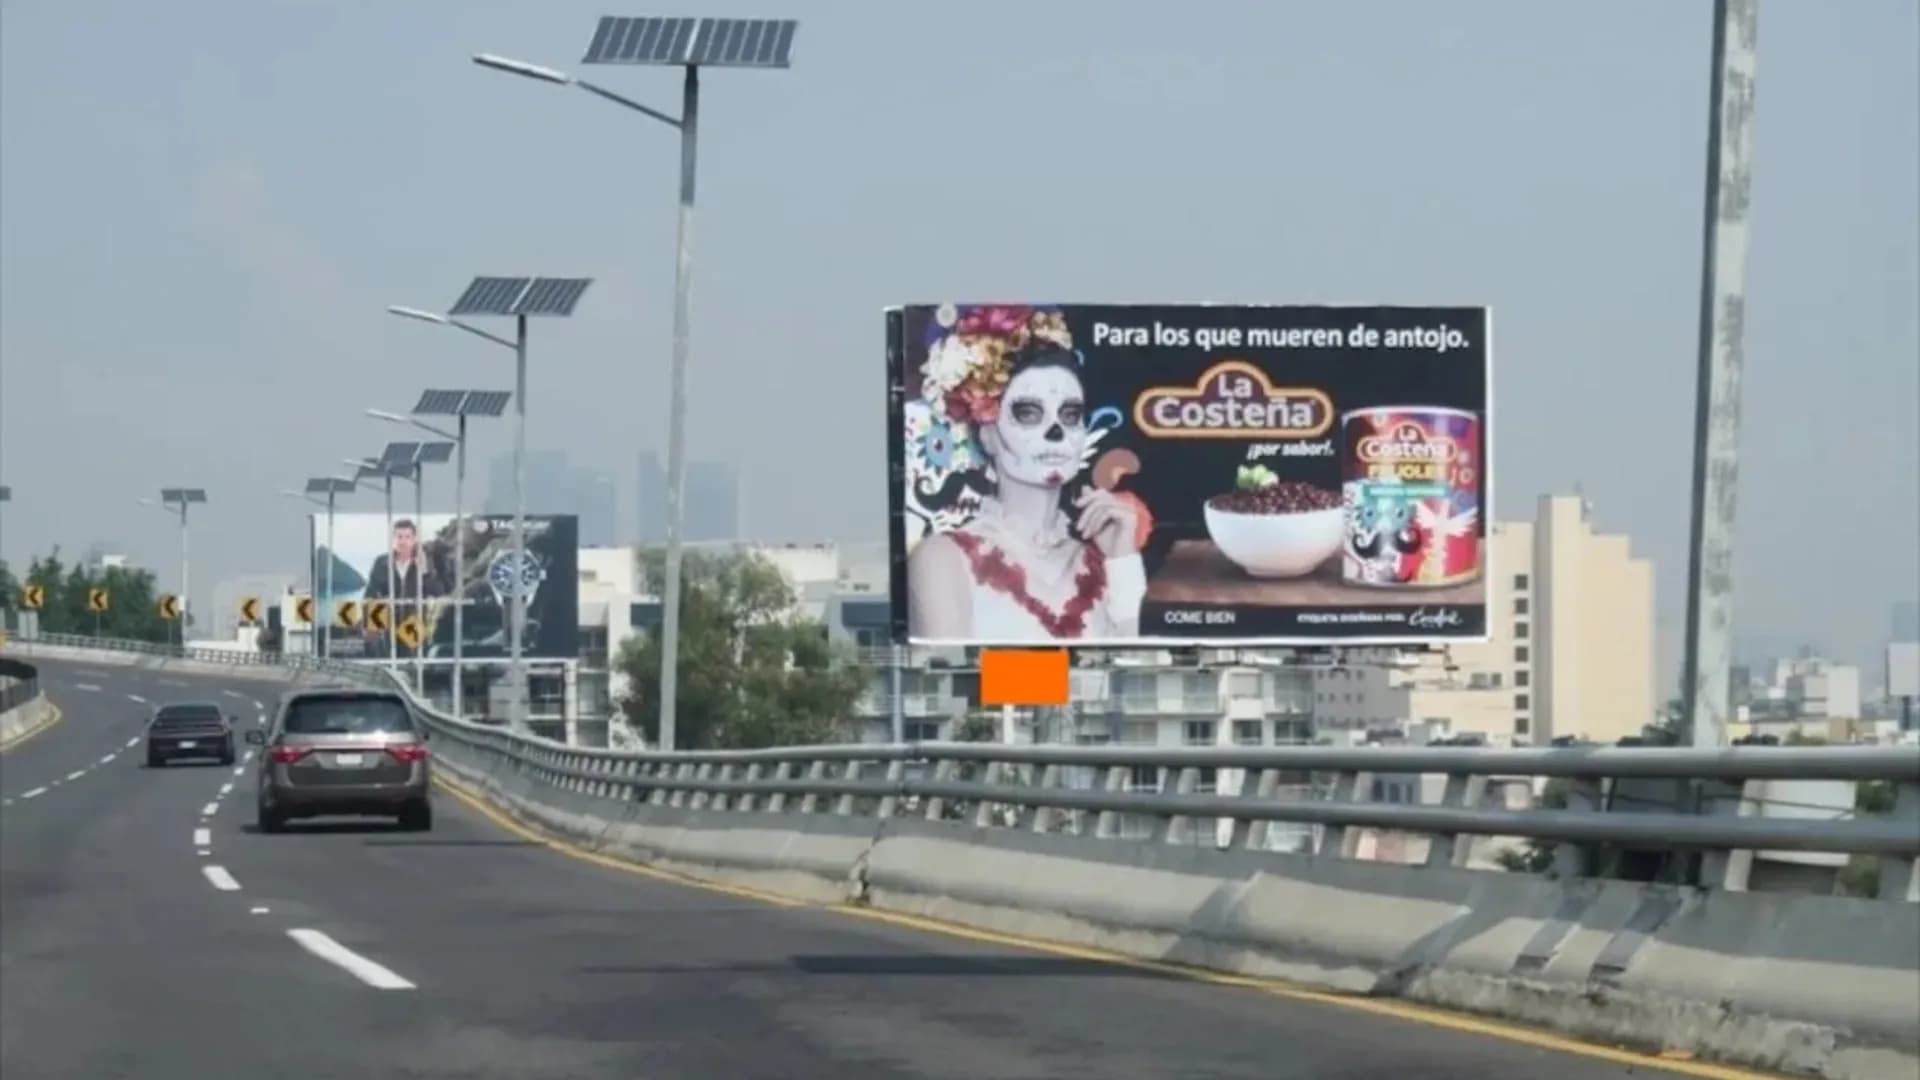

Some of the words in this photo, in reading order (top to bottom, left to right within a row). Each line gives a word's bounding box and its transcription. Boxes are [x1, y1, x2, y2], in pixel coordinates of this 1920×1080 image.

[1093, 322, 1149, 346] Para
[1154, 320, 1190, 346] los
[1195, 327, 1242, 351] que
[1247, 327, 1343, 347] mueren
[1348, 323, 1379, 347] de
[1384, 323, 1470, 352] antojo.
[1217, 373, 1253, 398] La
[1153, 395, 1314, 427] Costeña
[1164, 610, 1203, 624] COME
[1205, 610, 1236, 624] BIEN
